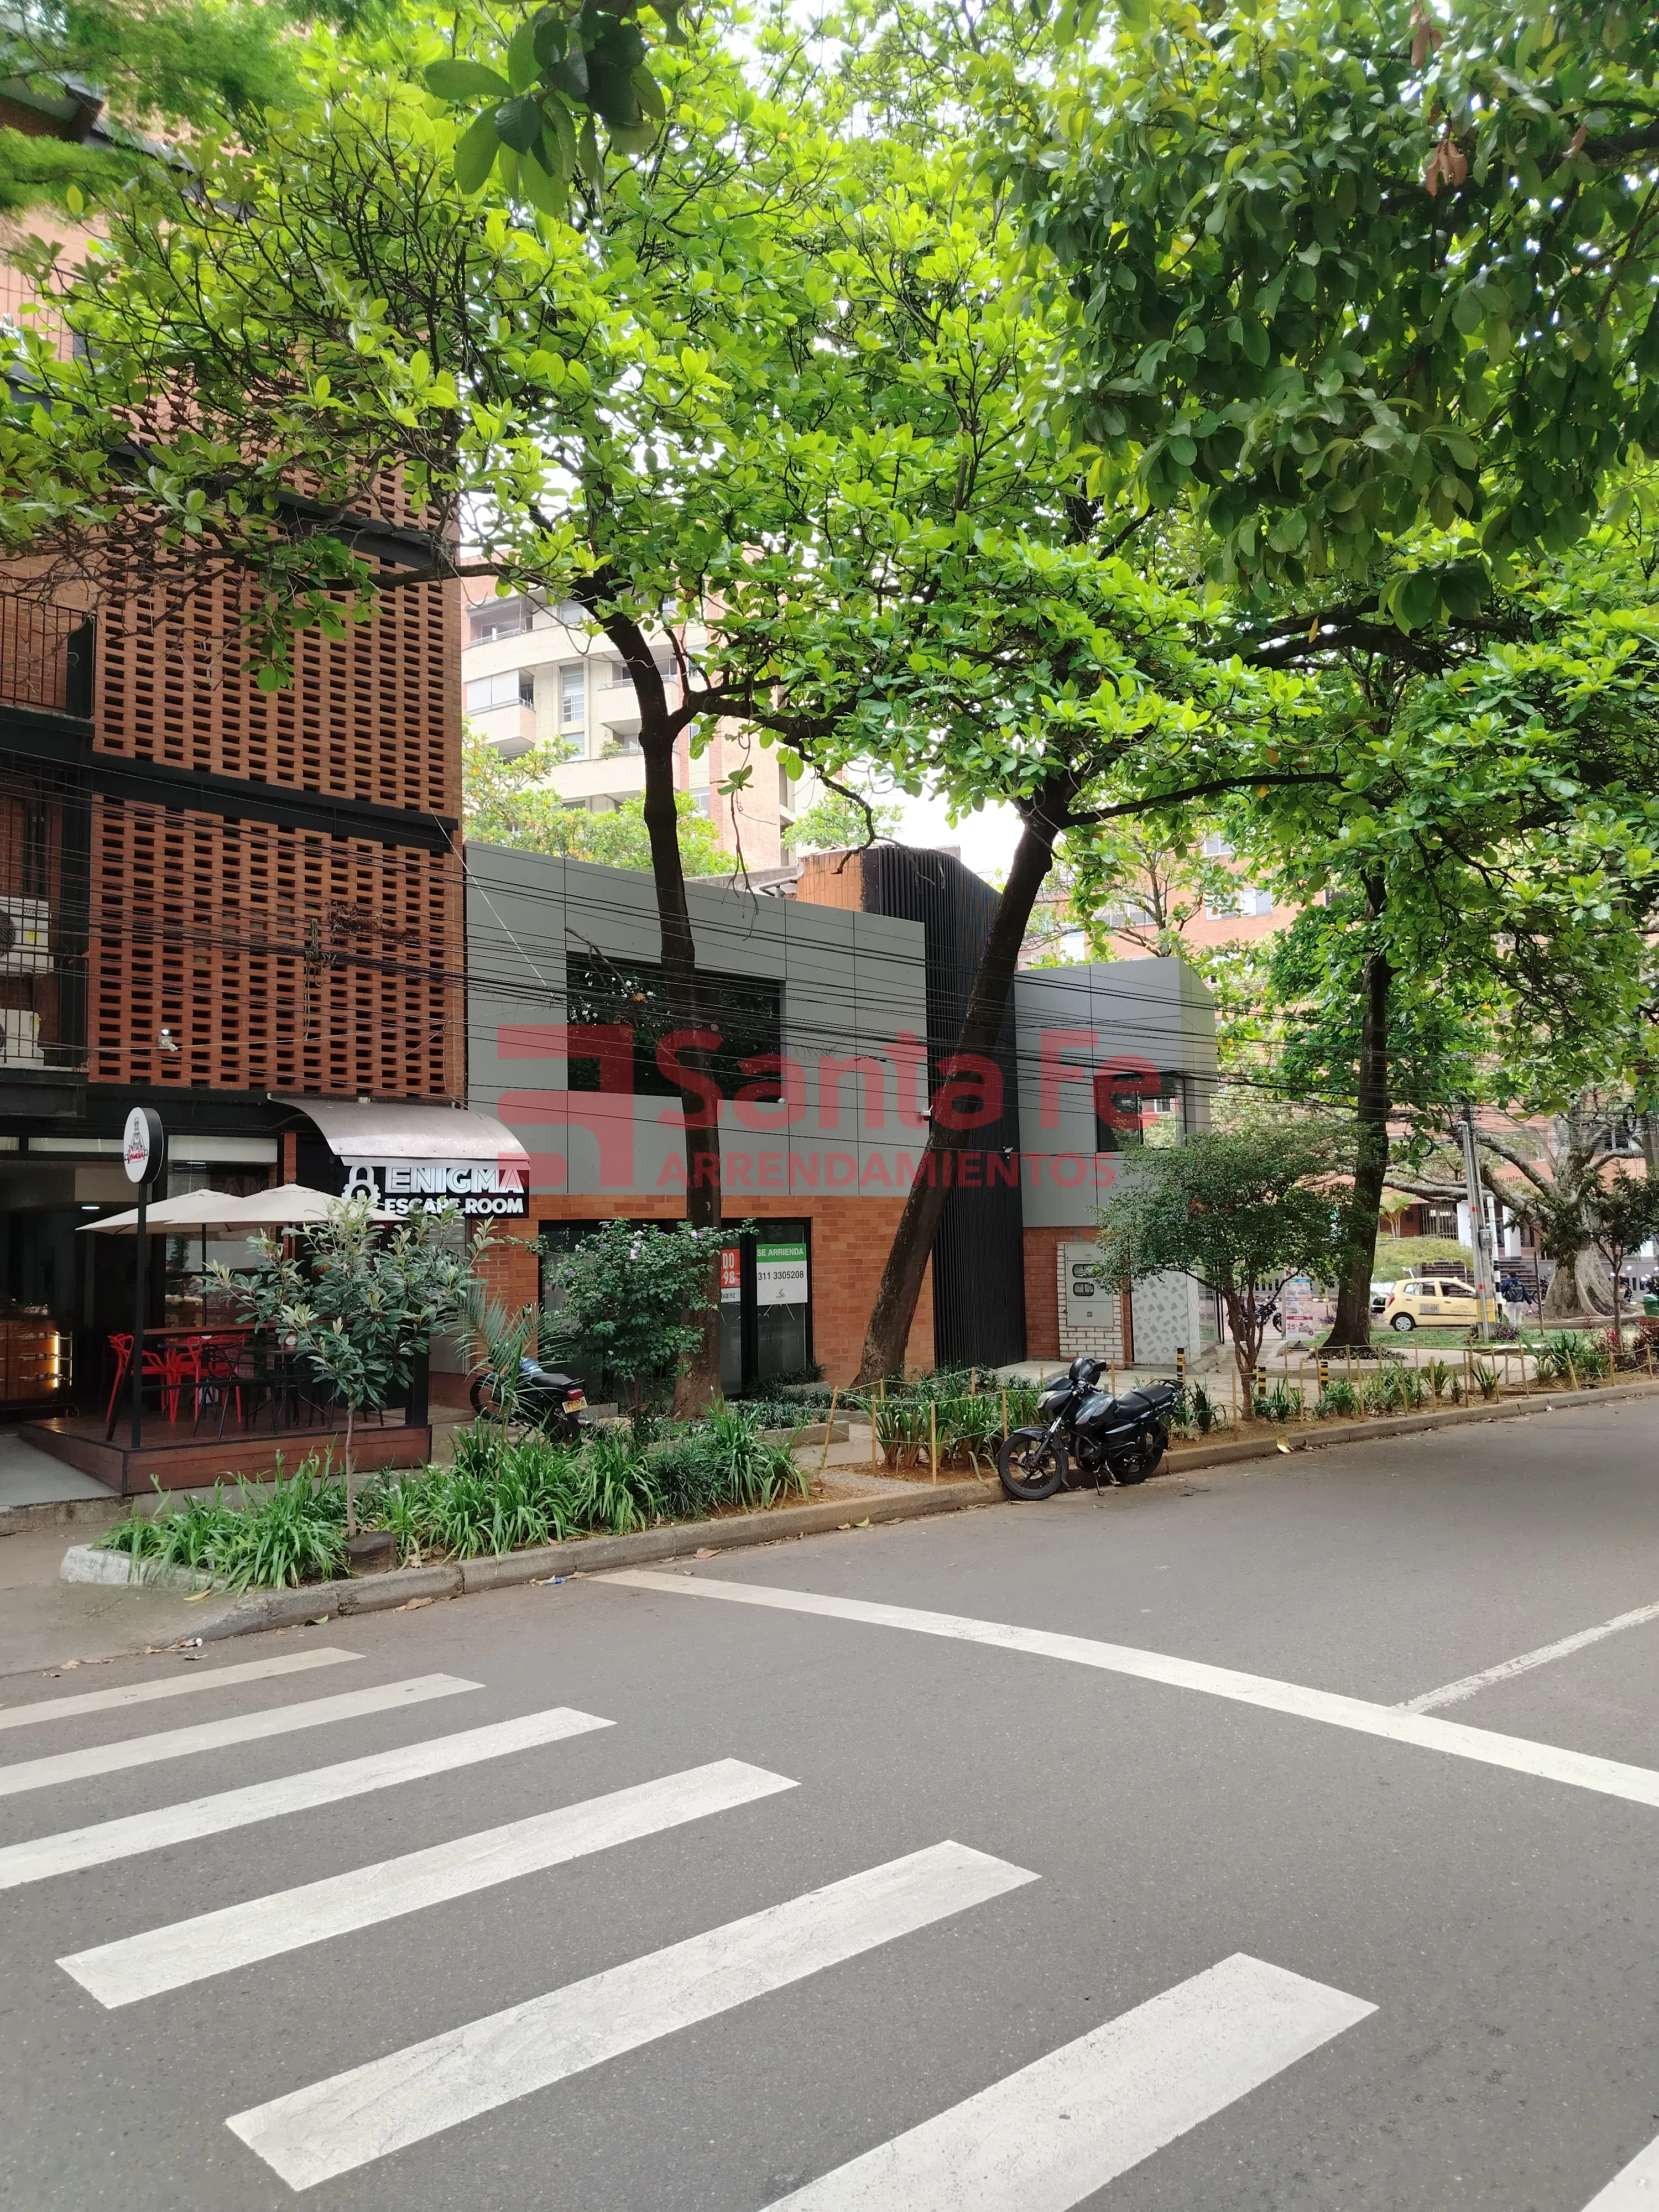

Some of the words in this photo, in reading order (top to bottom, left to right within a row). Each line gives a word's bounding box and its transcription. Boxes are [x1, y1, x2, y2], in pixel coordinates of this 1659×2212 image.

[385, 1166, 524, 1193] ENIGMA
[465, 1198, 524, 1214] ROOM
[768, 1248, 804, 1256] ARRIENDA
[758, 1272, 770, 1280] 311
[773, 1270, 804, 1280] 3305208
